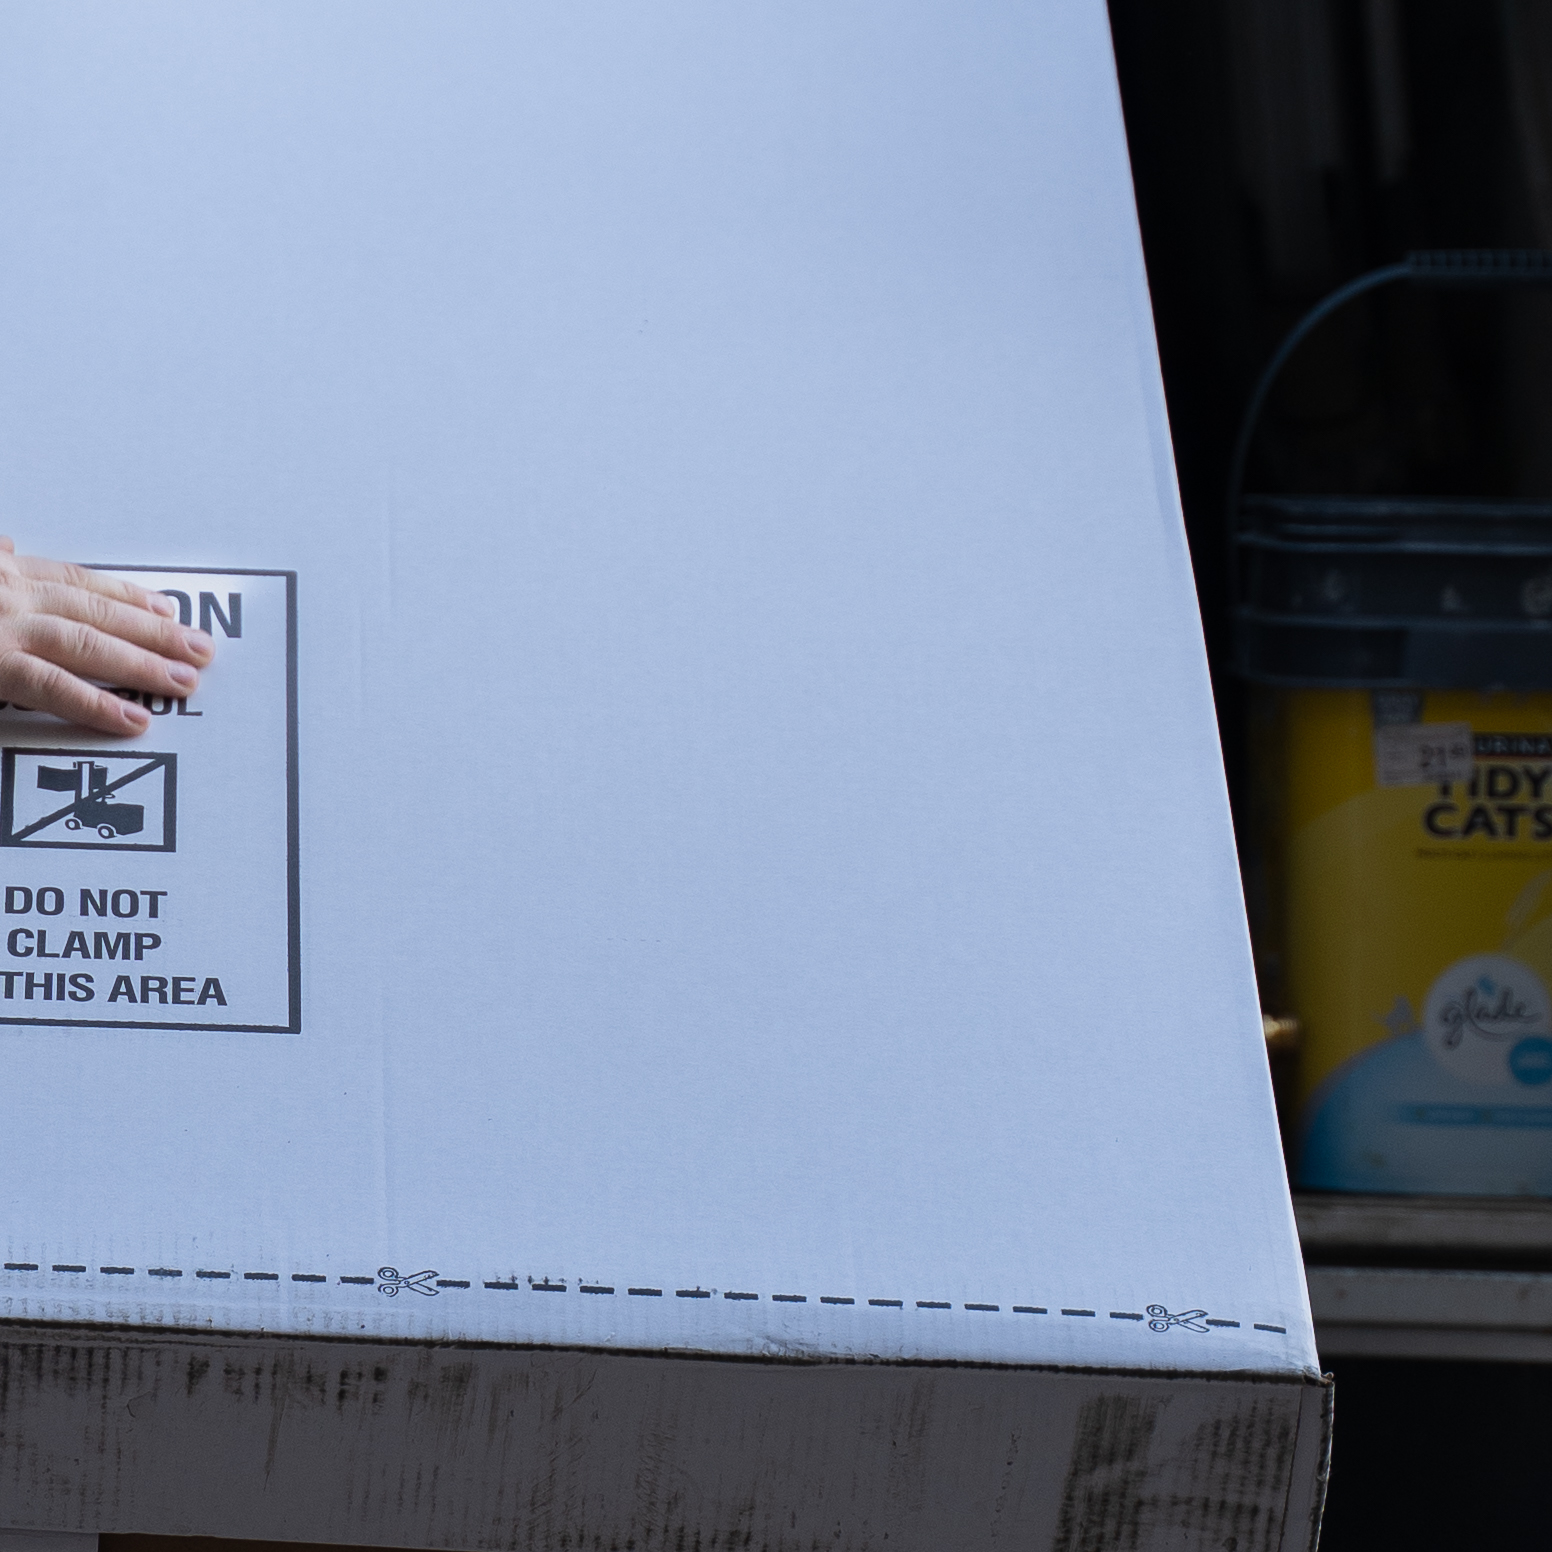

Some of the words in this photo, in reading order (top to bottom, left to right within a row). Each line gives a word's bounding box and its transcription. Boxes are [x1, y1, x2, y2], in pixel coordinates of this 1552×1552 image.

[1426, 803, 1552, 838] CATS
[4, 886, 65, 916] DO
[79, 888, 168, 919] NOT
[6, 928, 162, 961] CLAMP
[107, 975, 228, 1006] AREA
